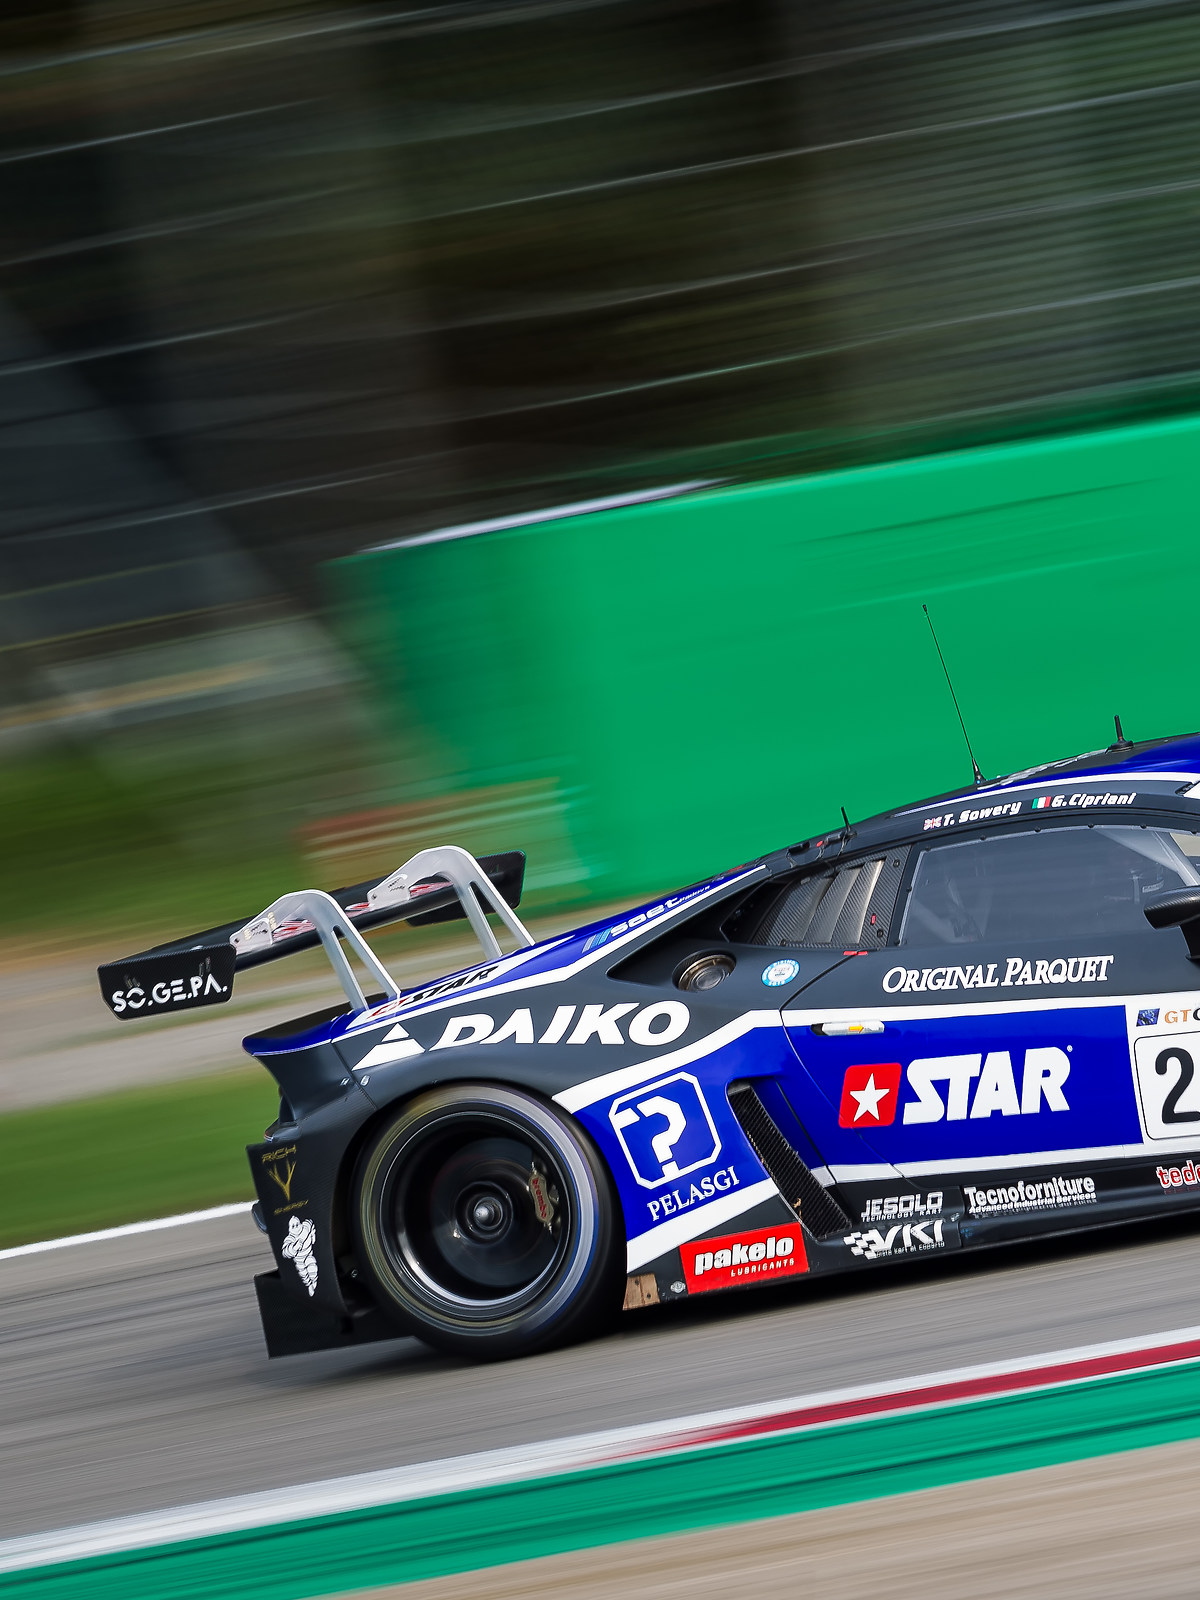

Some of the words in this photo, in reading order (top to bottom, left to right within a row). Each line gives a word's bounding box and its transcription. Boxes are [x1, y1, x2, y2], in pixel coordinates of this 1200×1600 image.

[943, 814, 955, 827] T.
[958, 801, 1022, 824] Sowery
[610, 897, 681, 938] saet
[400, 965, 499, 1007] STAR
[882, 963, 1000, 994] ORIGINAL
[1000, 954, 1114, 987] PARQUET
[429, 1000, 690, 1052] DAIKO
[903, 1046, 1071, 1125] STAR
[646, 1165, 740, 1222] PELASGI
[861, 1191, 943, 1218] JESOLO
[964, 1176, 1096, 1207] Tecnoforniture
[694, 1236, 794, 1276] pakelo
[730, 1257, 795, 1278] LUBRICANTS
